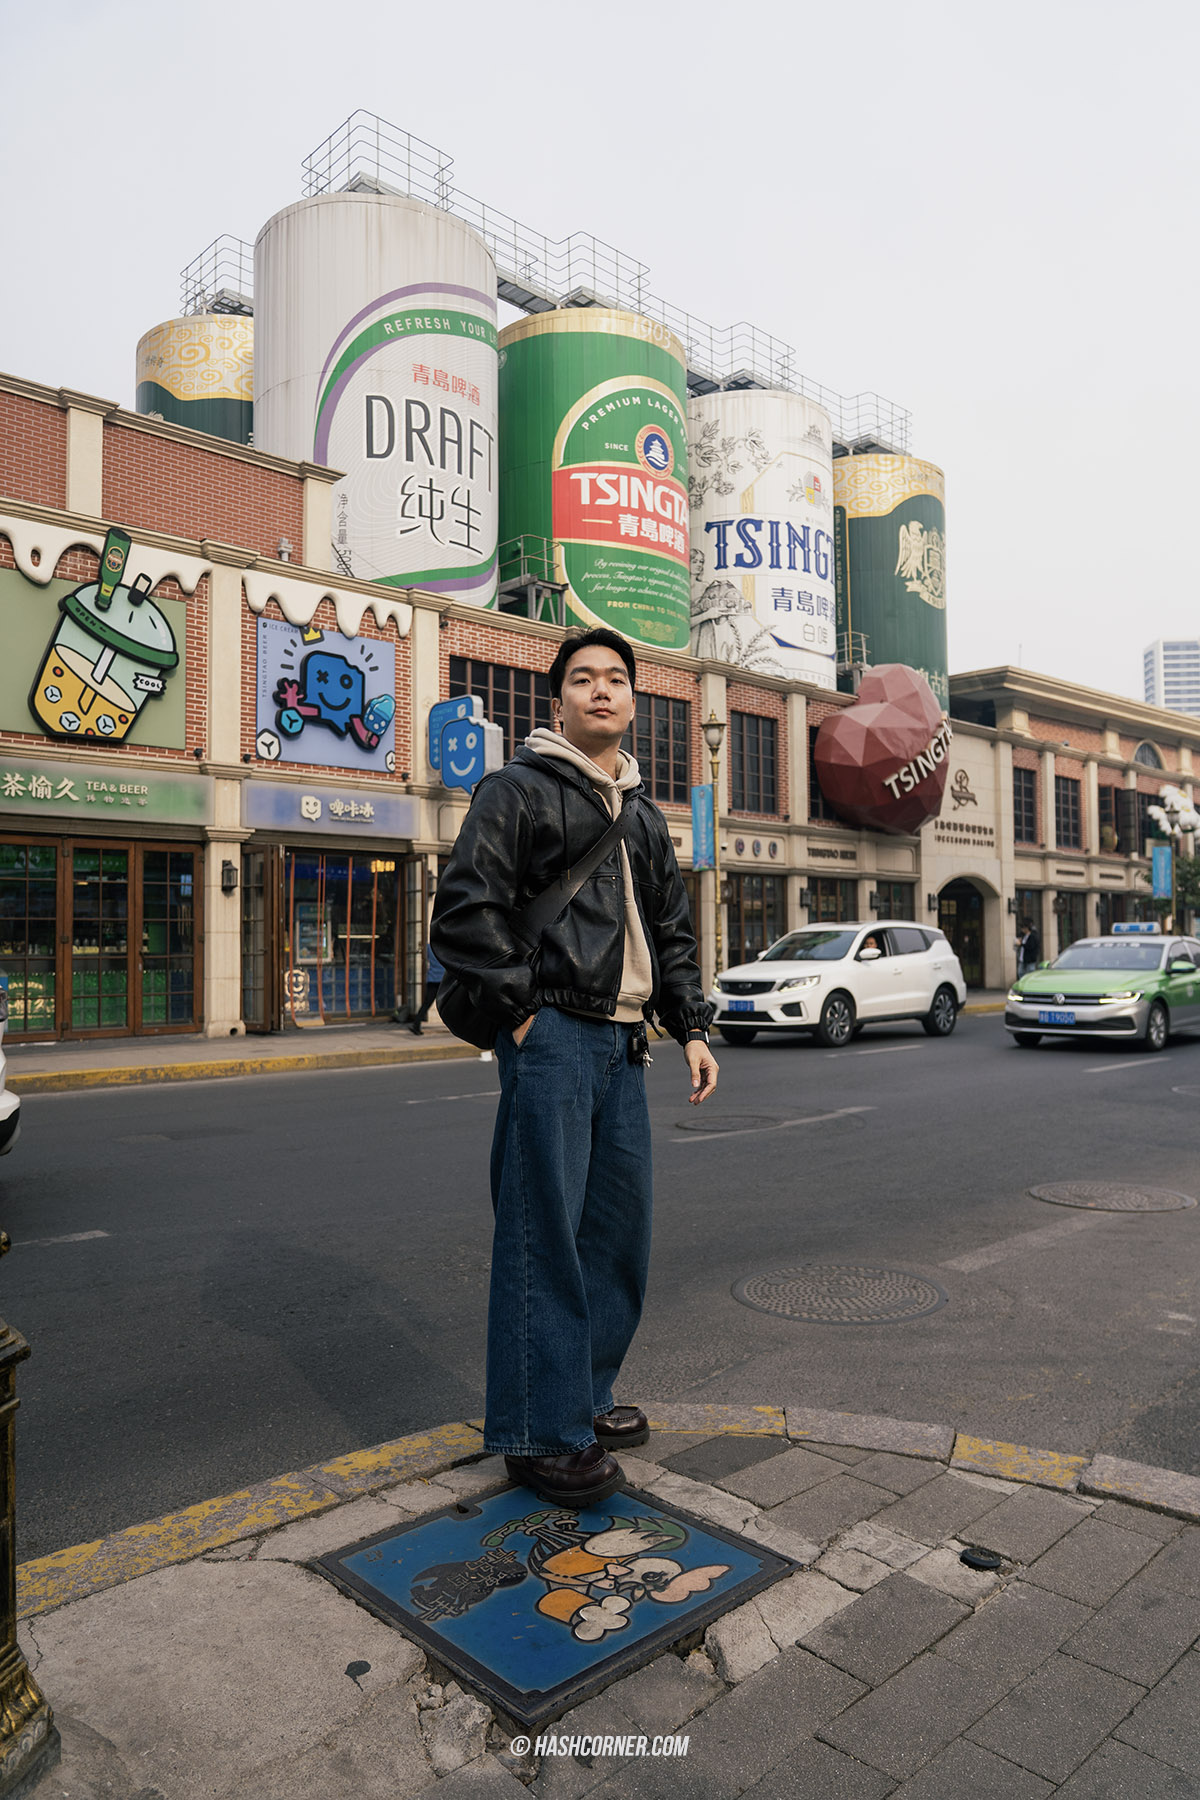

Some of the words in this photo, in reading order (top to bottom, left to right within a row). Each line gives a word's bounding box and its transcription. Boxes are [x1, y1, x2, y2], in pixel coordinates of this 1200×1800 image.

[384, 317, 451, 334] REFRESH
[460, 320, 486, 338] YOUR
[412, 363, 480, 406] 青島啤酒
[581, 396, 641, 431] PREMIUM
[647, 398, 679, 425] LAGER
[366, 395, 494, 493] DRAFT
[604, 442, 629, 451] SINCE
[569, 472, 689, 534] TSINGTA
[400, 475, 483, 555] 纯生
[618, 513, 685, 555] 青島啤酒
[607, 600, 630, 609] FROM
[75, 606, 97, 627] OPEN
[269, 623, 278, 631] ICE
[280, 624, 299, 634] CREAM
[139, 679, 161, 689] COOL
[86, 780, 108, 792] TEA
[109, 783, 117, 793] &
[119, 783, 149, 795] BEER
